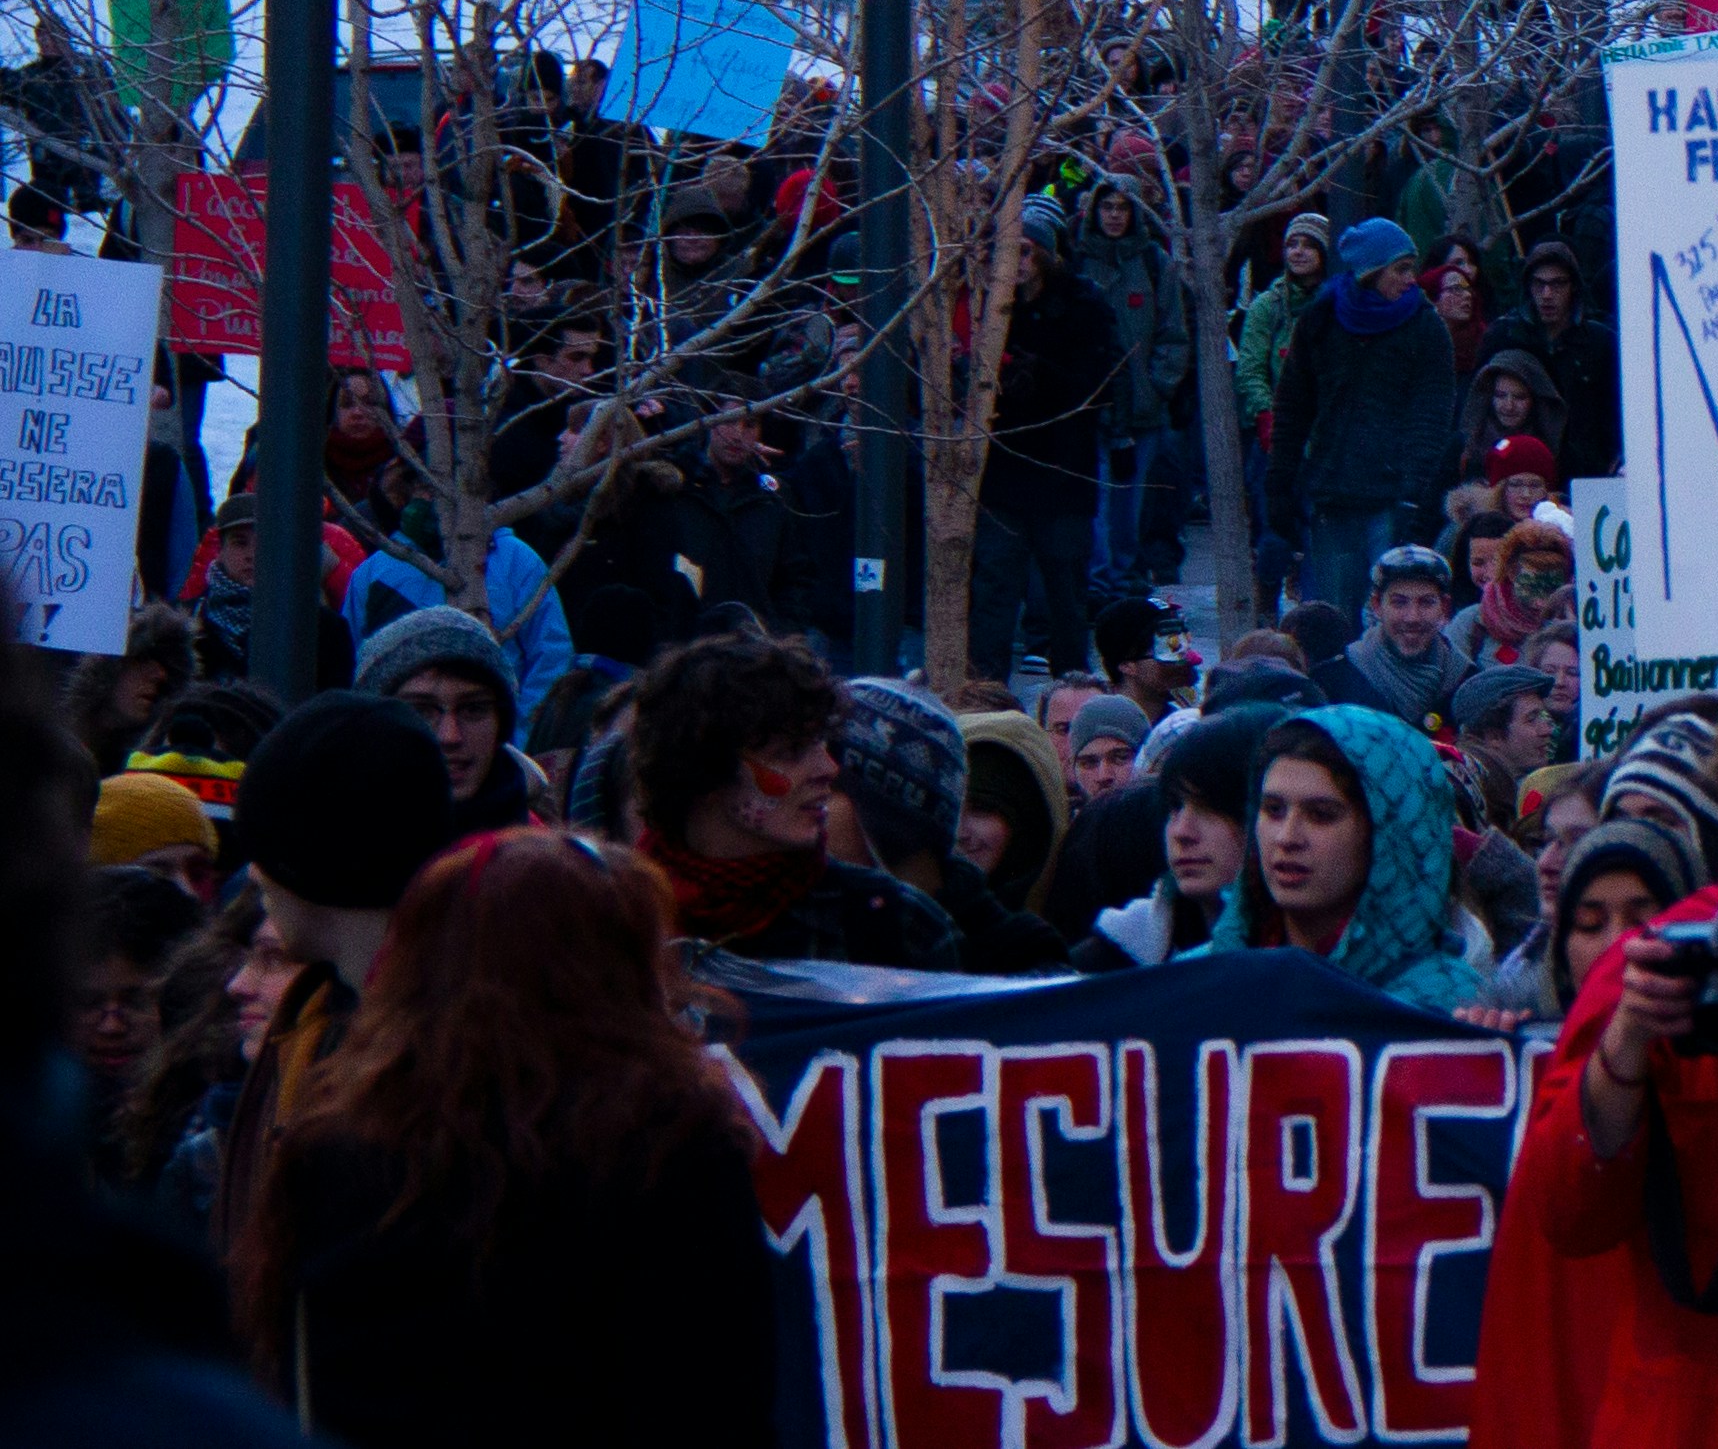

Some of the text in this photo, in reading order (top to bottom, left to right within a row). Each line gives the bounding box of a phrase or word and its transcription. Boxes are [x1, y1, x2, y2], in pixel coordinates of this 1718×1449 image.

[30, 287, 83, 329] LA
[0, 341, 143, 406] AUSSE
[18, 408, 72, 455] NE
[0, 460, 129, 510] SSERA
[1593, 505, 1632, 573] Co
[700, 1037, 1557, 1449] MESURE
